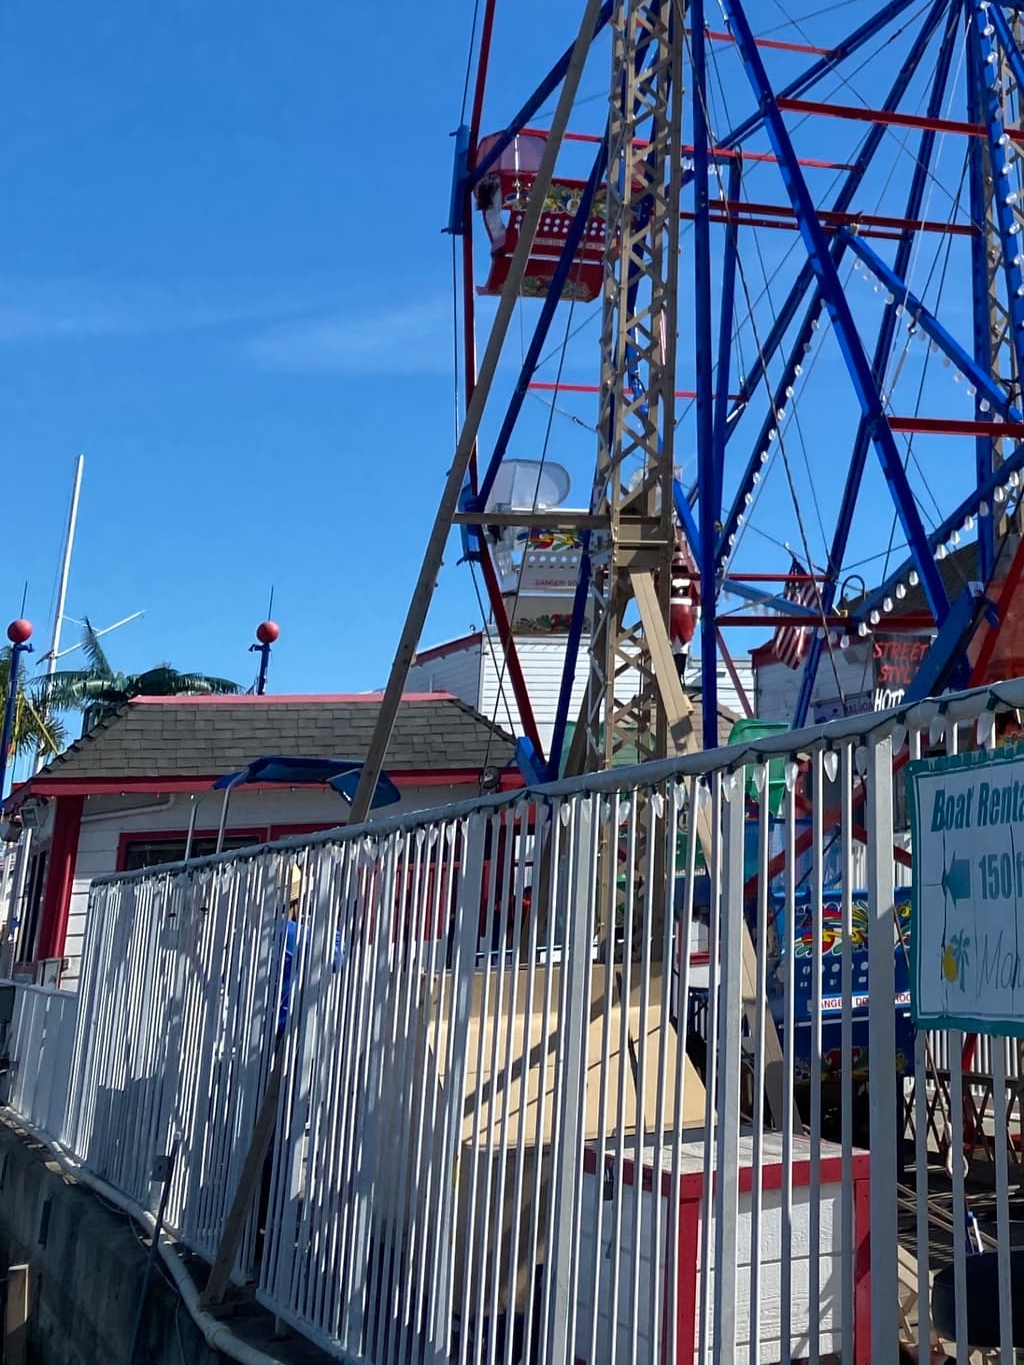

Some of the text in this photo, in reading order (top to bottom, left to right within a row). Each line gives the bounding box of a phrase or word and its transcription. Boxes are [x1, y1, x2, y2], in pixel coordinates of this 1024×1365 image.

[873, 642, 928, 661] STREET
[930, 787, 974, 833] Boat
[978, 852, 1013, 901] 150
